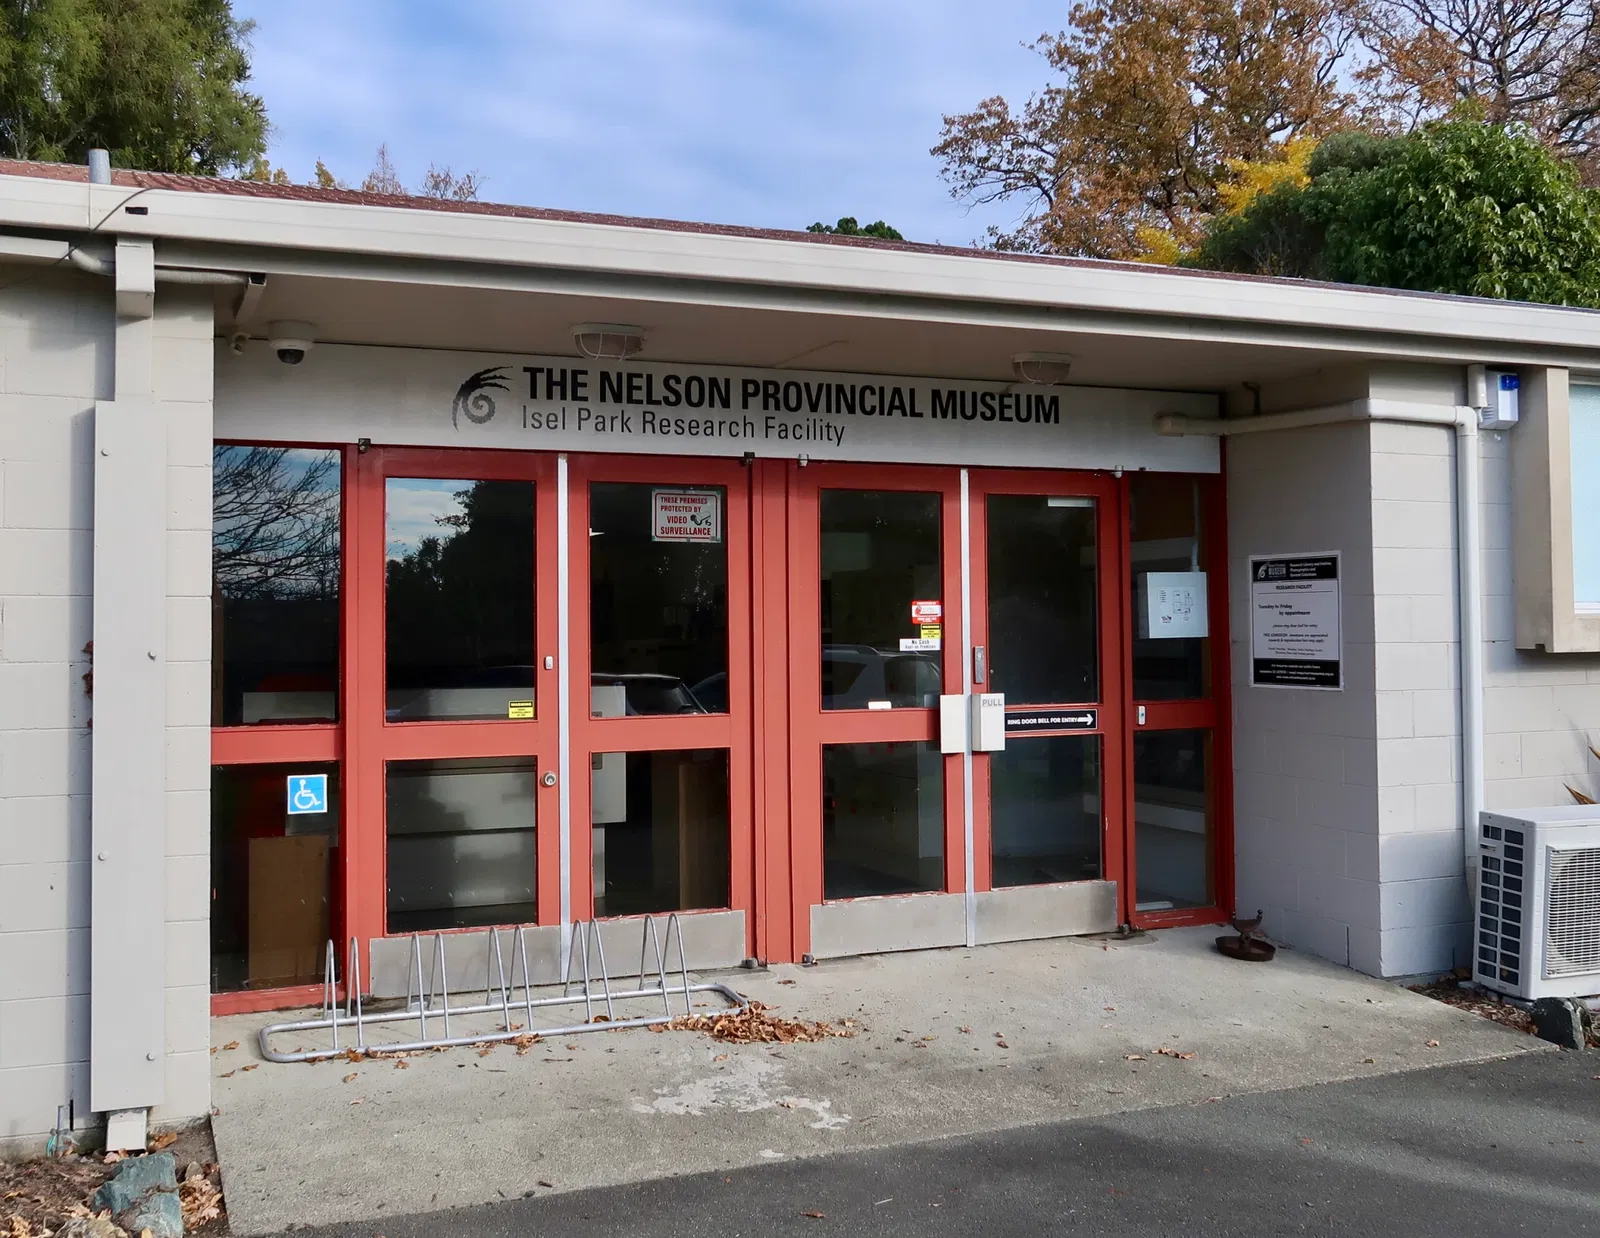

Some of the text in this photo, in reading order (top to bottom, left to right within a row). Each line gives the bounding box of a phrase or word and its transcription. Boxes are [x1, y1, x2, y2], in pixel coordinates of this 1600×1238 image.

[522, 366, 1060, 425] THE NELSON PROVINCIAL MUSEUM
[522, 405, 846, 446] Isel Park Research Facility
[660, 496, 708, 505] THESE PREMISES
[666, 516, 688, 524] VIDEO
[660, 527, 711, 536] SURVEILLANCE
[982, 698, 1003, 707] PULL
